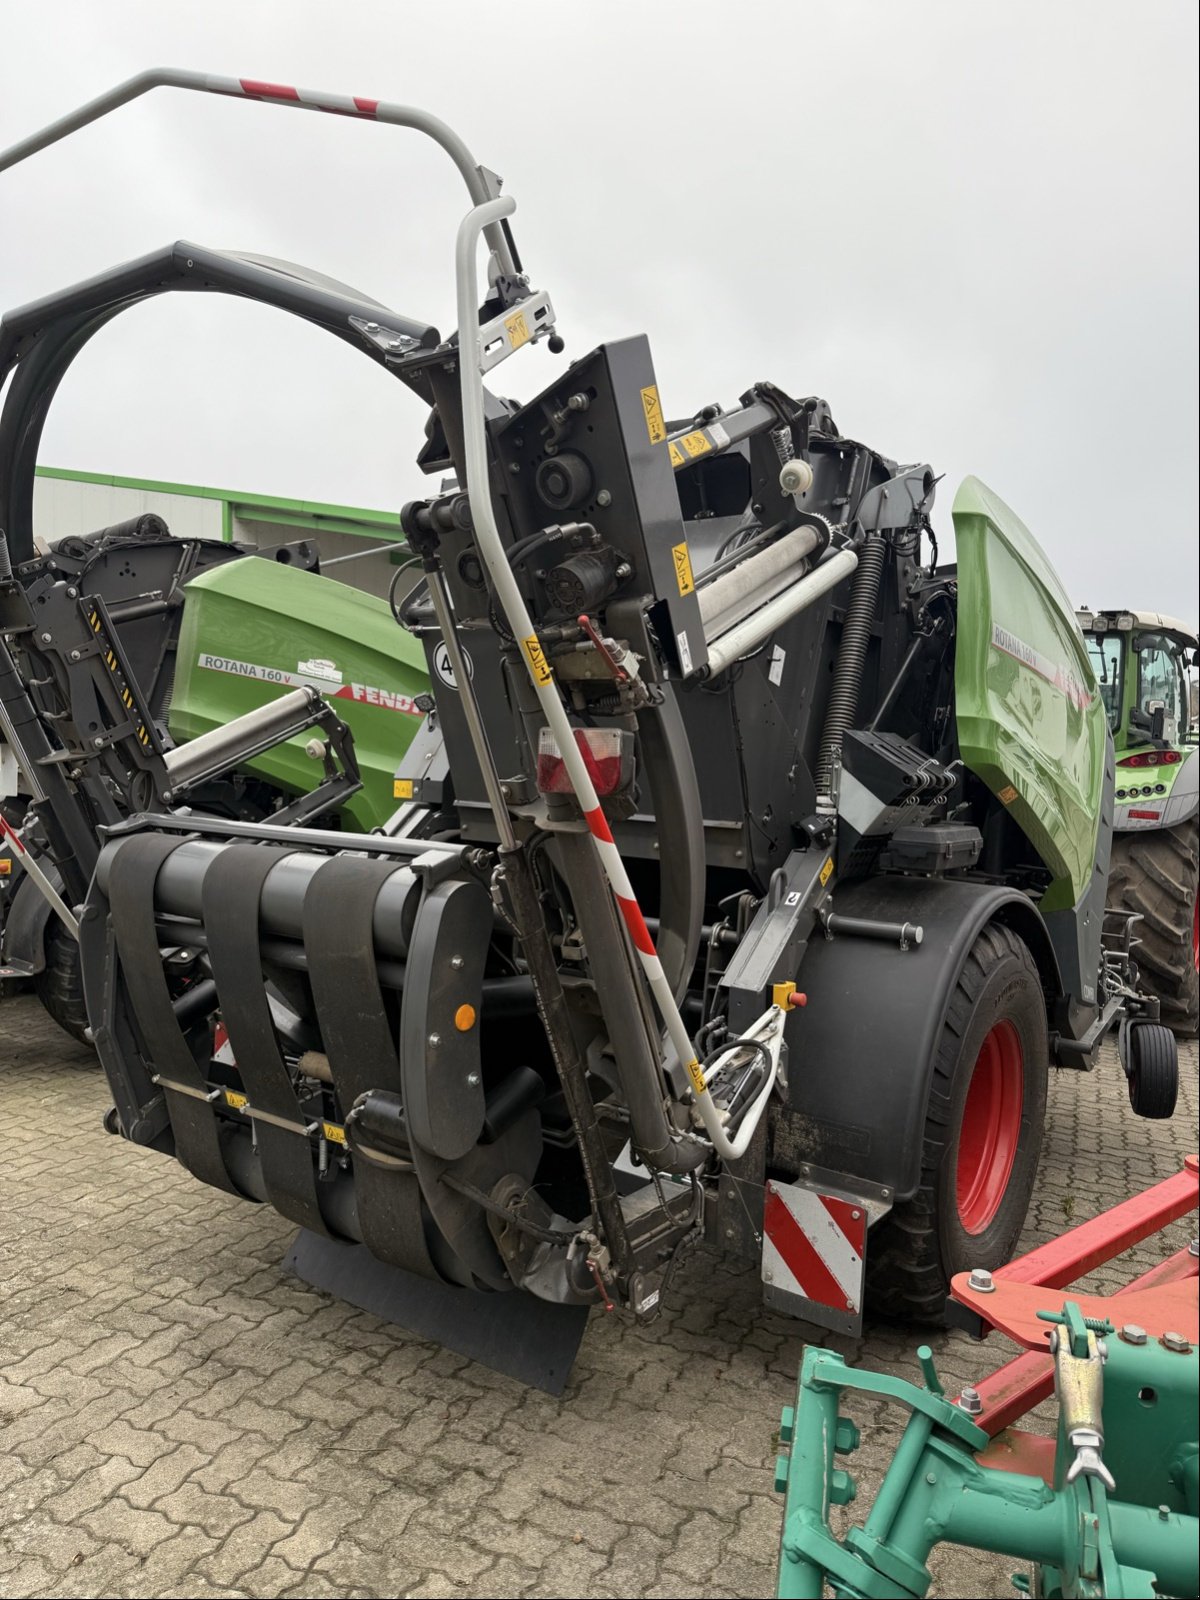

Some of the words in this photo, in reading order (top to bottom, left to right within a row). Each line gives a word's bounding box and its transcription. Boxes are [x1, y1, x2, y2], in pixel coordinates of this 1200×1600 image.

[995, 626, 1022, 657] ROTANA
[204, 656, 257, 677] ROTANA
[260, 668, 282, 682] 160
